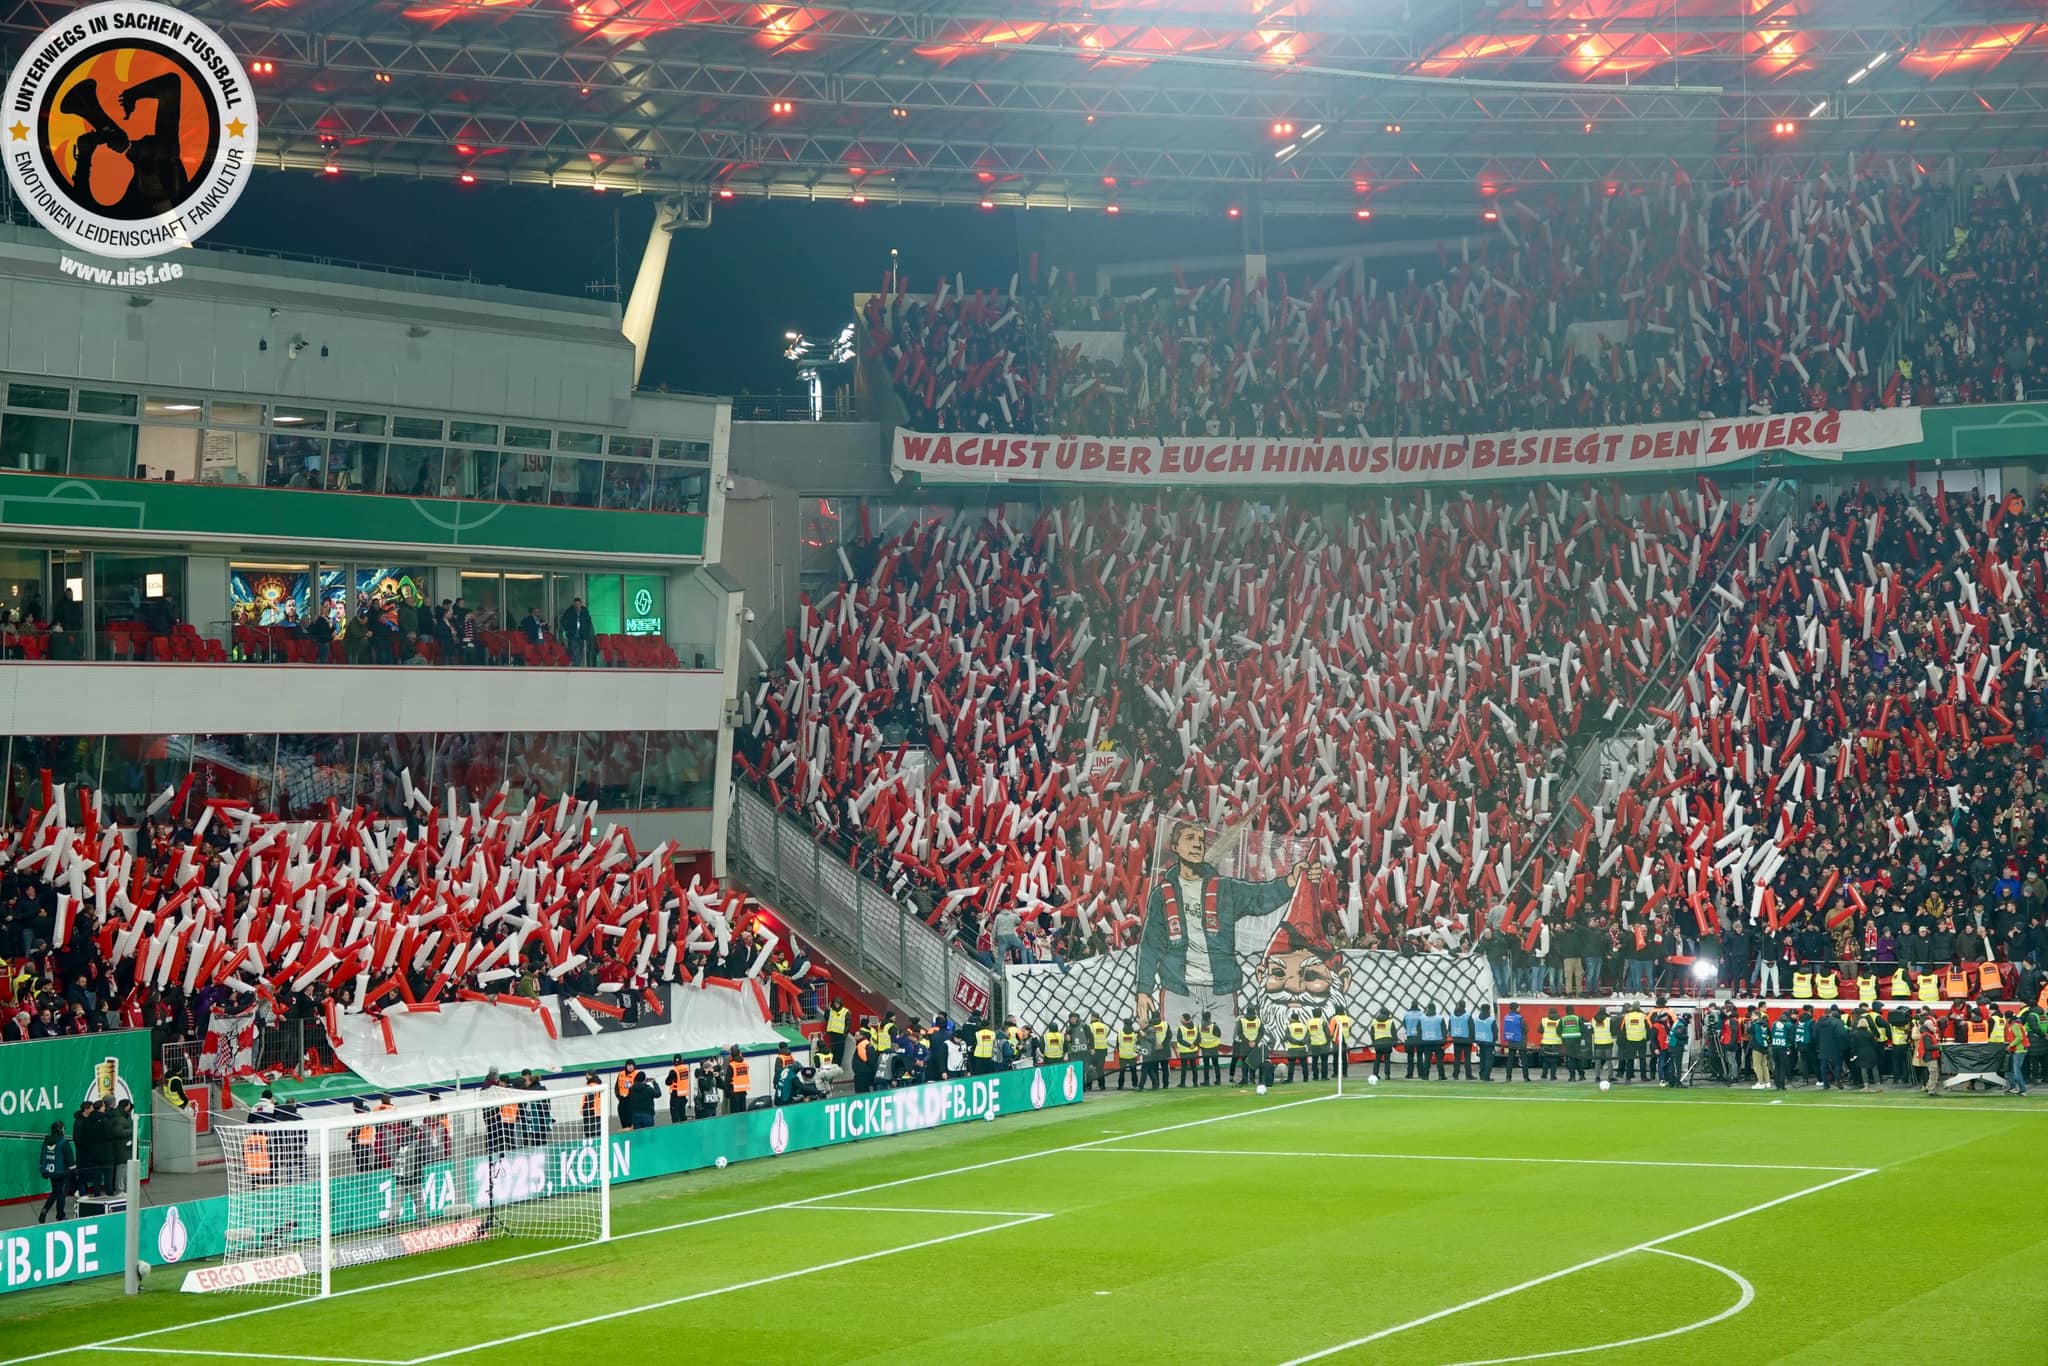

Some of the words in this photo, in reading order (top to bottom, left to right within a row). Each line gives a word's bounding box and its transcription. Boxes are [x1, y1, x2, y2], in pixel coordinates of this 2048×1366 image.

[902, 436, 1050, 469] WACHST
[1055, 435, 1152, 475] ÜBER
[1159, 444, 1256, 473] EUCH
[1261, 444, 1389, 473] HINAUS
[1397, 442, 1466, 471] UND
[1472, 433, 1624, 468] BESIEGT
[1630, 428, 1700, 460] DEN
[1706, 410, 1841, 454] ZWERG
[0, 1085, 63, 1115] OKAL
[825, 1078, 1000, 1140] TICKETS.DFB.DE
[560, 1138, 630, 1187] KÖN
[195, 1265, 247, 1290] ERGO
[252, 1256, 301, 1279] ERGO
[340, 1244, 388, 1264] freenet
